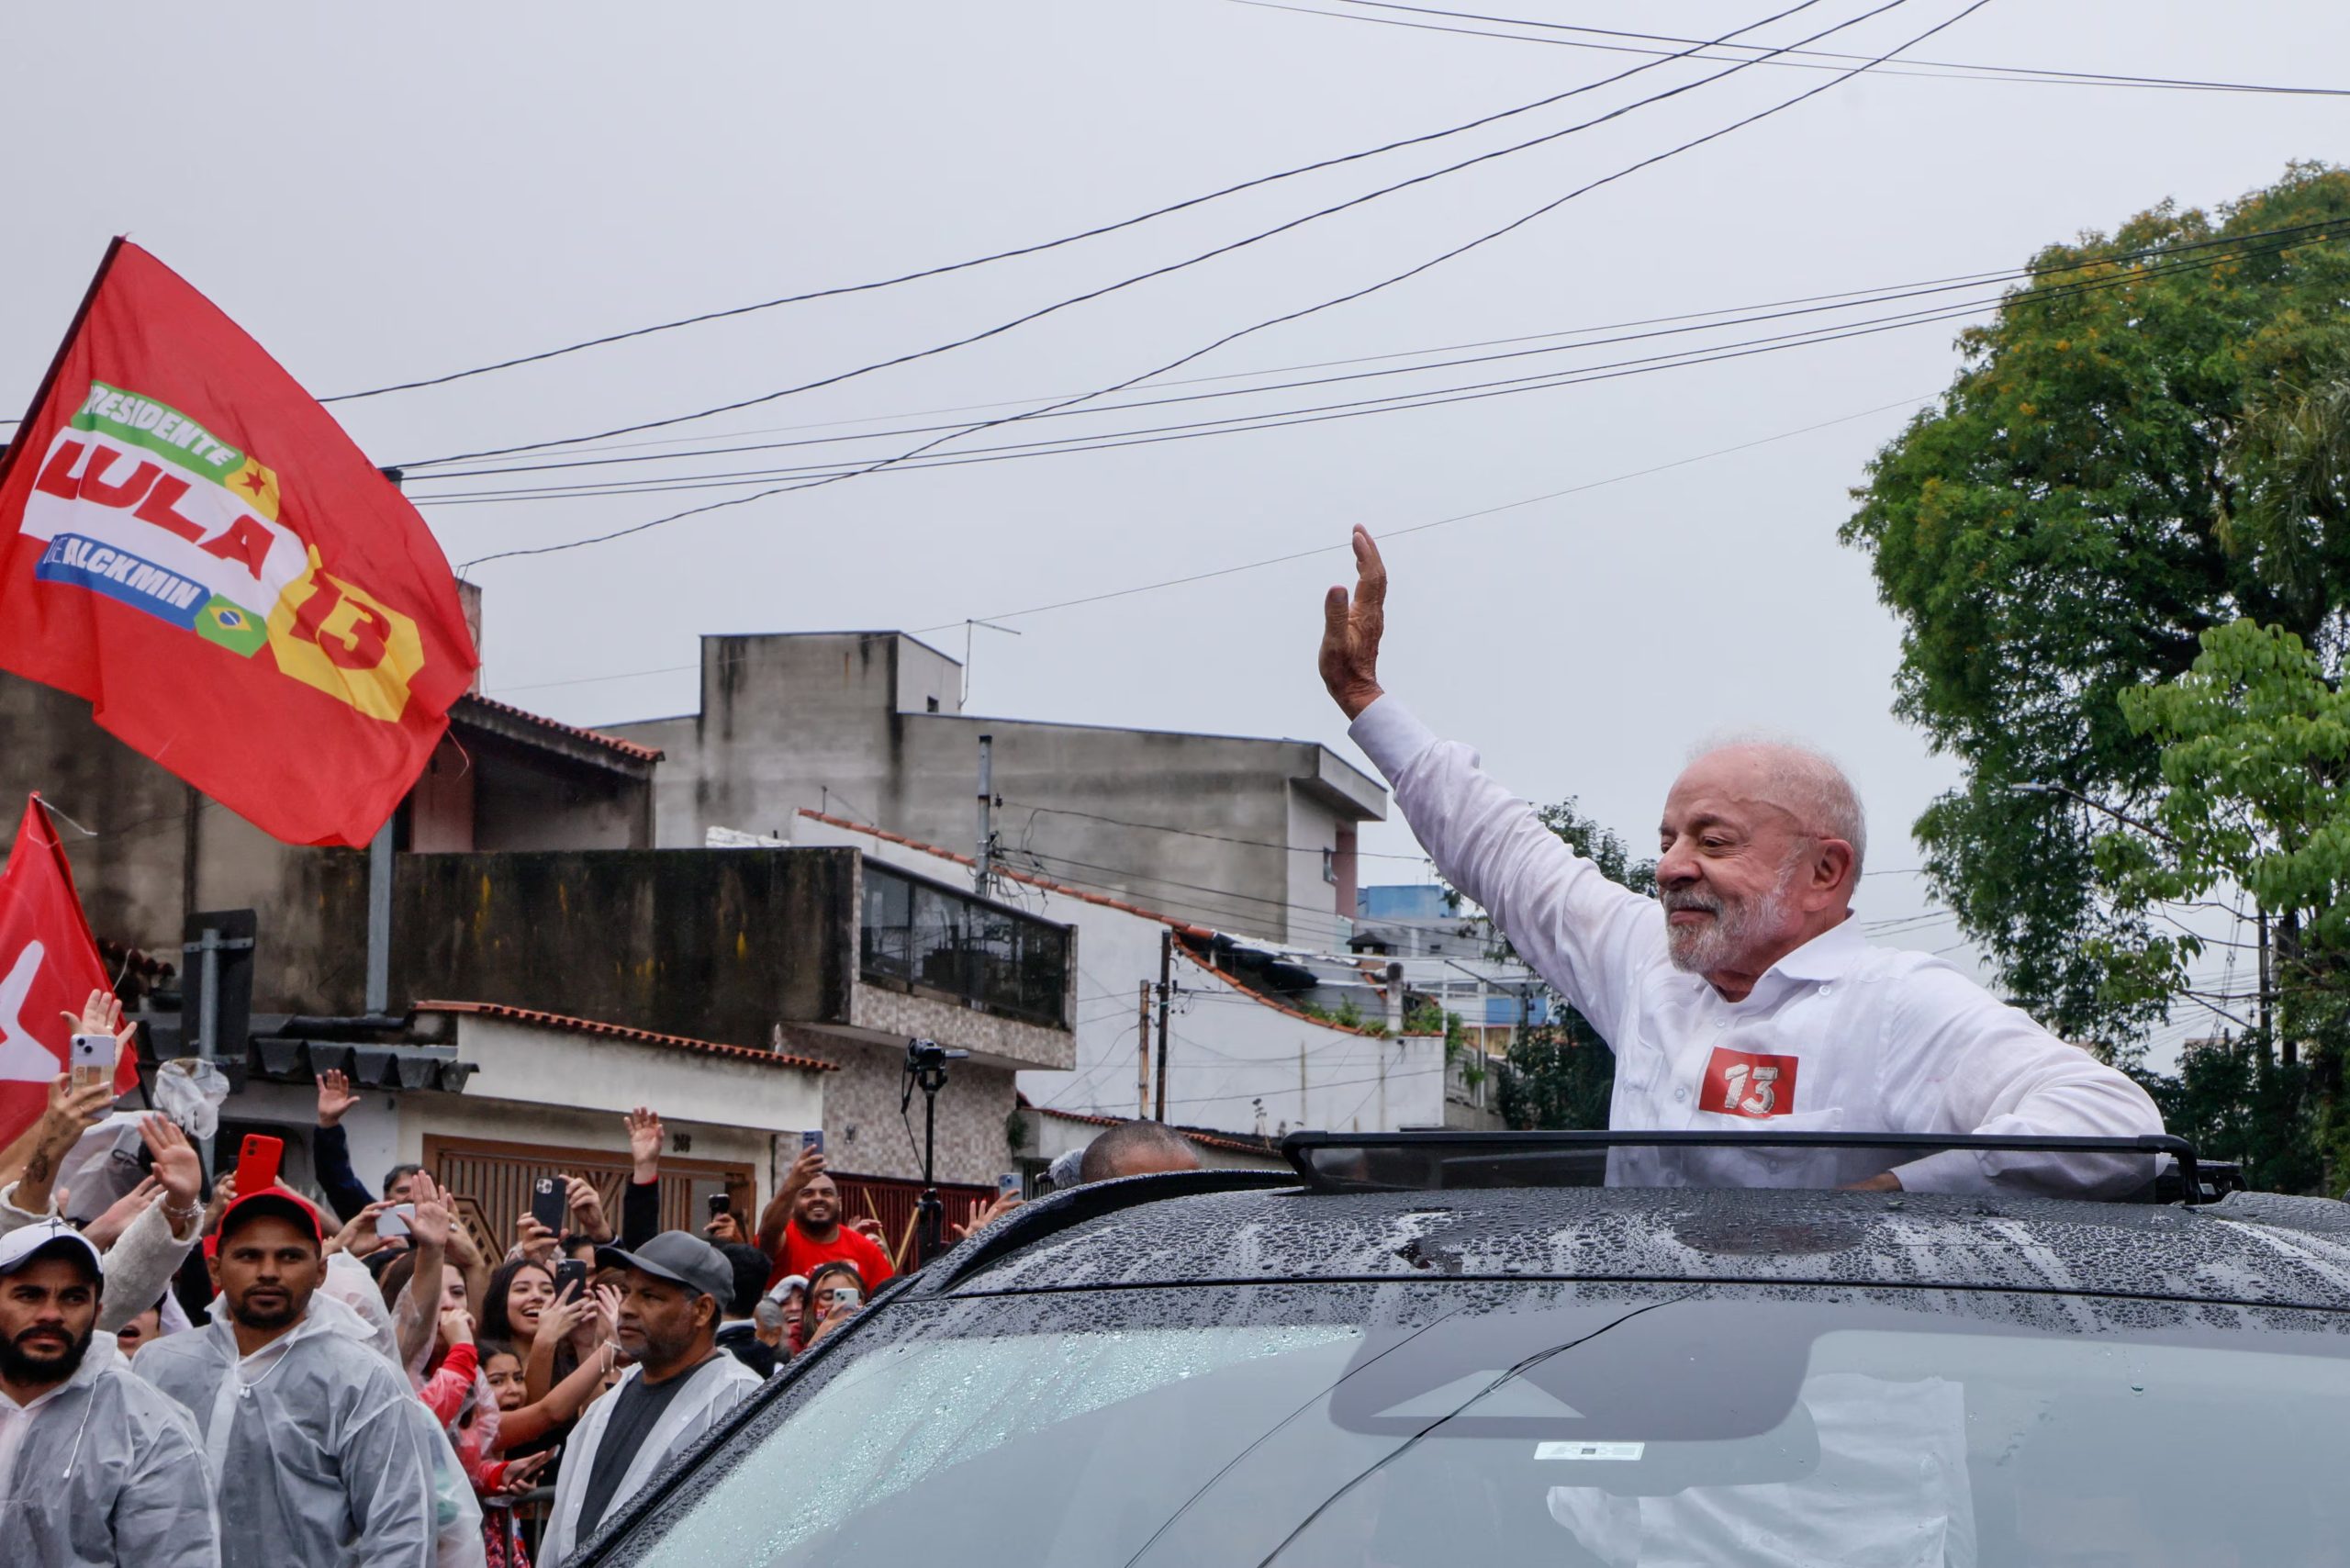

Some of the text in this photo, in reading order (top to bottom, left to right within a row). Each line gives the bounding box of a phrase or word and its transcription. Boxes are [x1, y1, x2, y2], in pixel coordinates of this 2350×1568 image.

[83, 385, 237, 466] RESIDENTE
[35, 439, 274, 581] LULA
[62, 538, 202, 610] ALCKMIN
[288, 567, 391, 670] 13
[1724, 1063, 1779, 1114] 13
